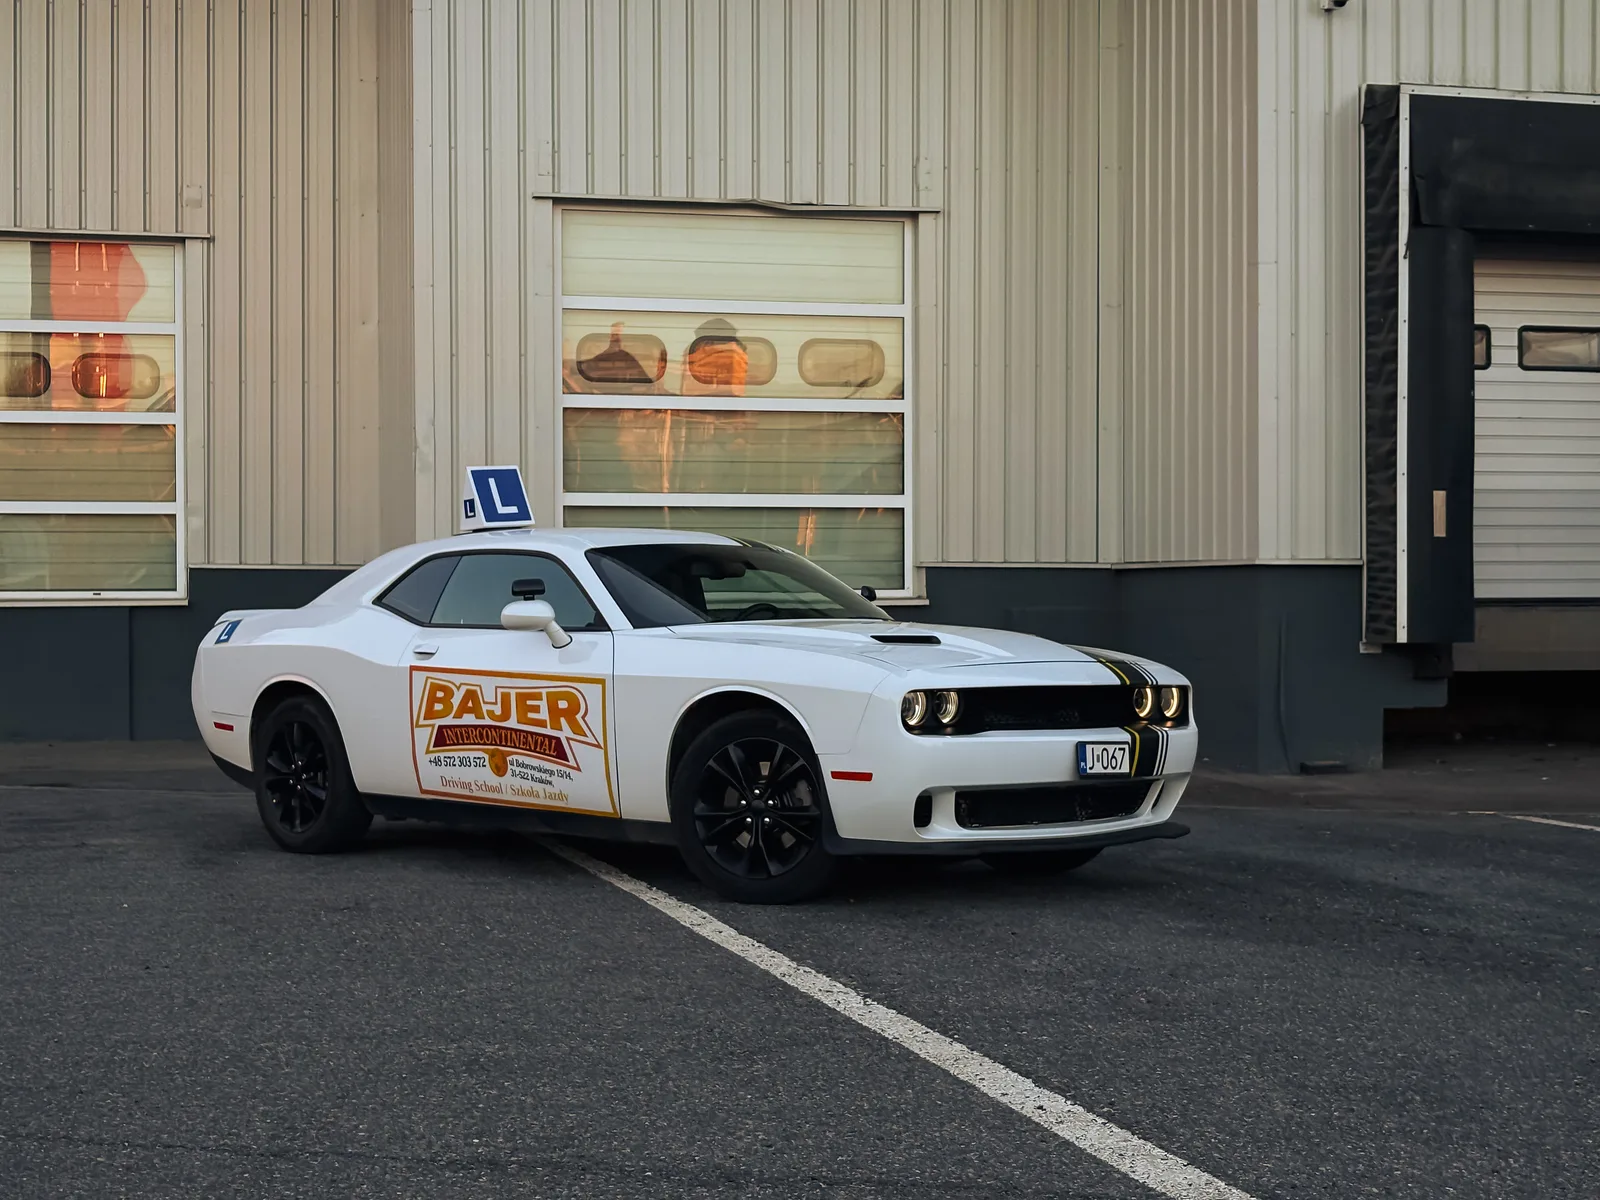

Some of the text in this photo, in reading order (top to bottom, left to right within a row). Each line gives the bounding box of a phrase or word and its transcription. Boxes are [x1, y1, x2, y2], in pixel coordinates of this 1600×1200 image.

[488, 477, 519, 514] L
[466, 501, 475, 516] L
[220, 623, 232, 640] L
[423, 681, 589, 738] BAJER
[443, 727, 557, 756] INTERCONTINENTAL
[428, 755, 487, 768] +48 572 303 572
[515, 758, 556, 778] Bobrowskiego
[1080, 761, 1087, 769] PL
[510, 768, 530, 781] 31-522
[440, 775, 474, 794] Driving
[473, 779, 504, 795] School
[543, 788, 569, 806] Jazdy
